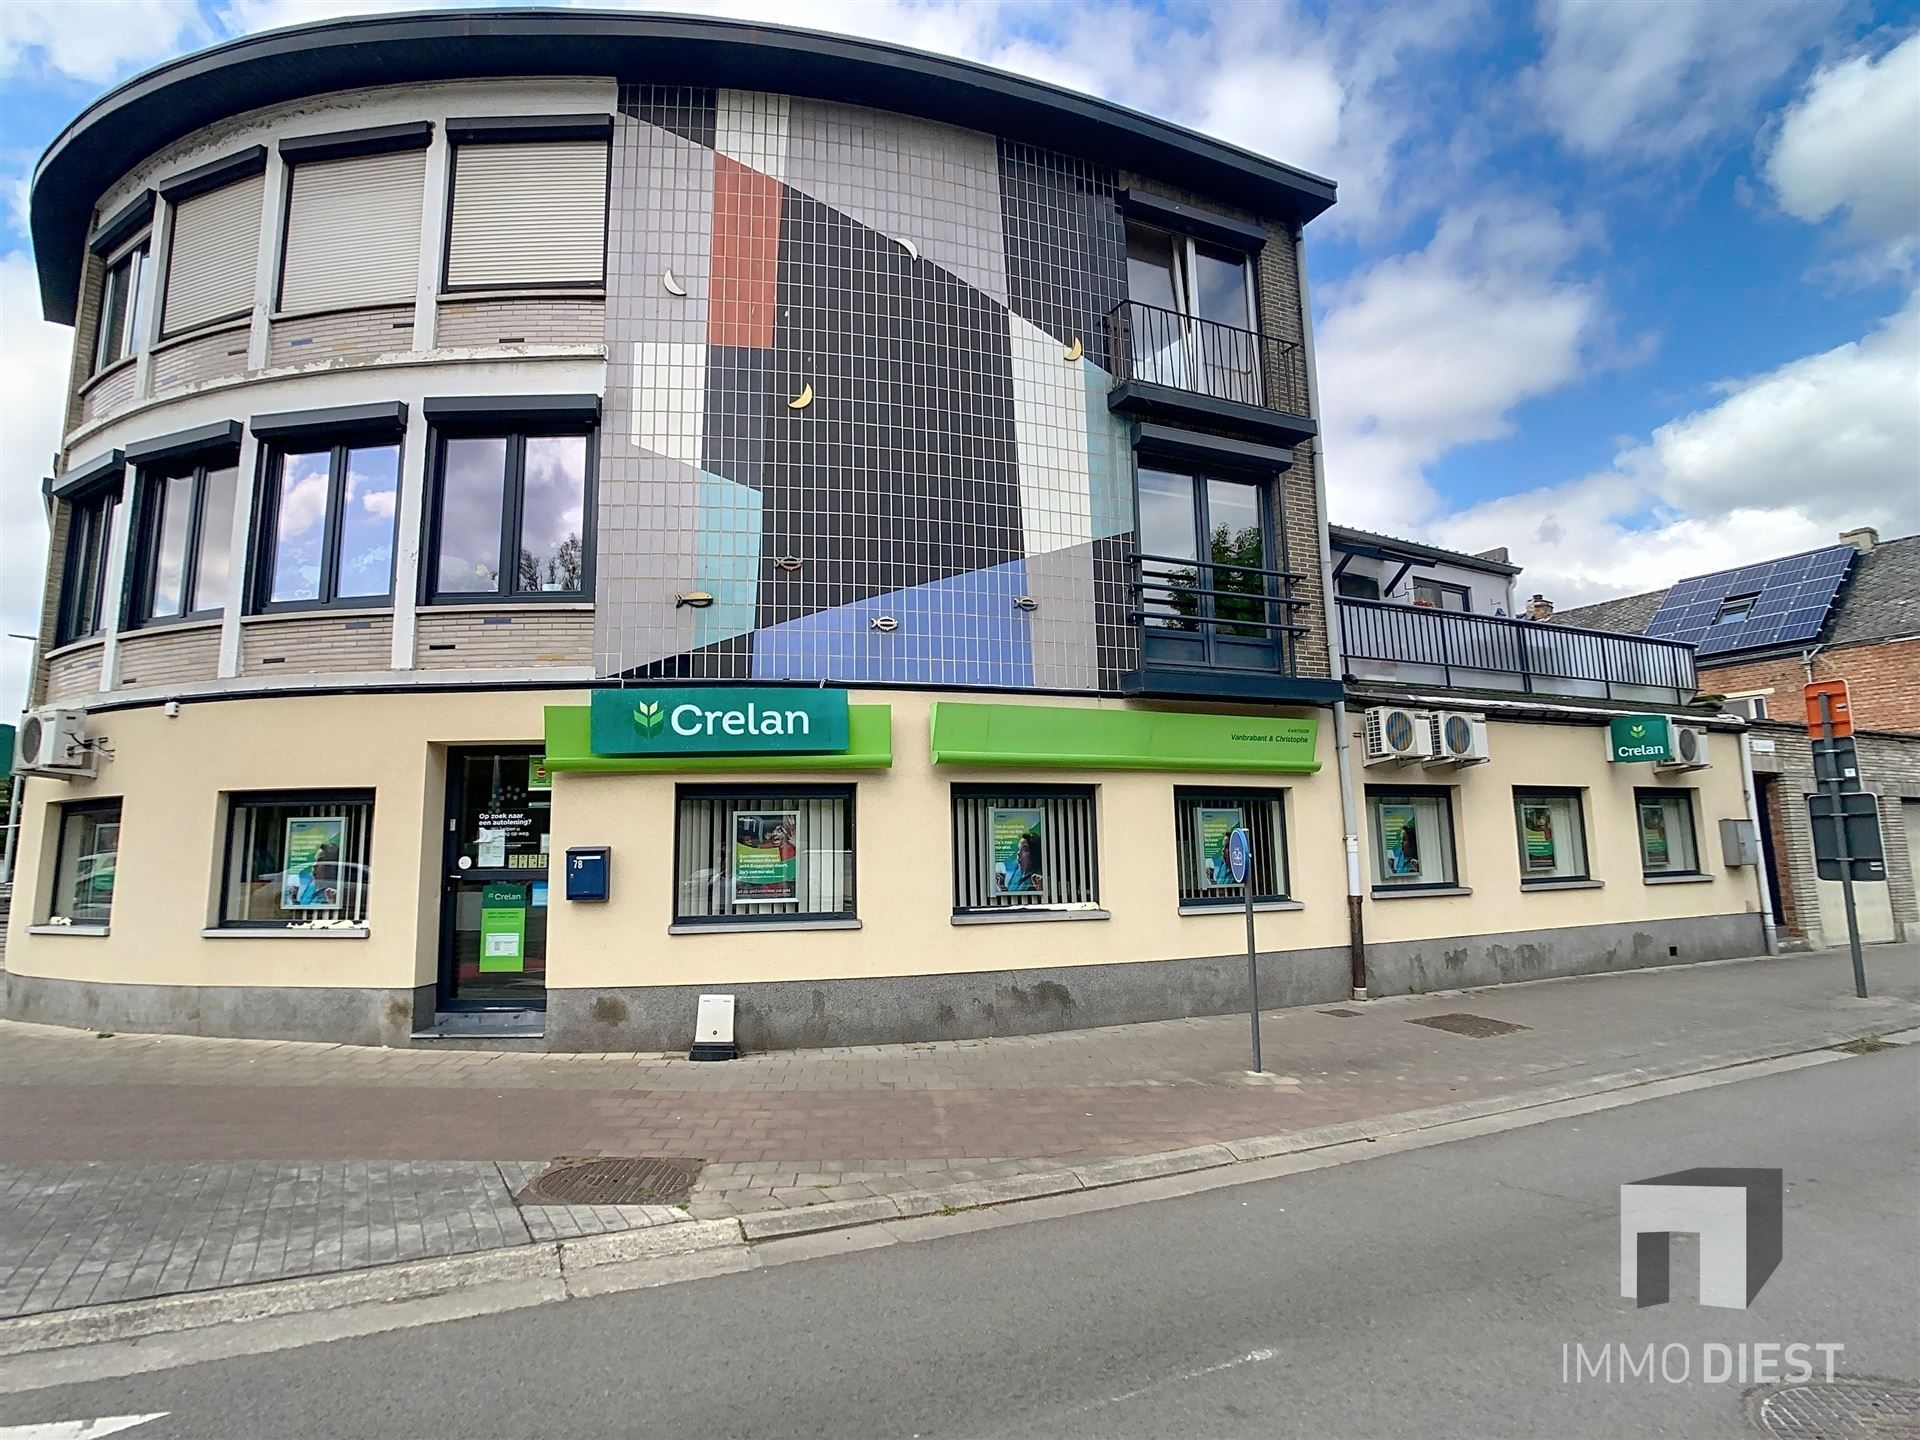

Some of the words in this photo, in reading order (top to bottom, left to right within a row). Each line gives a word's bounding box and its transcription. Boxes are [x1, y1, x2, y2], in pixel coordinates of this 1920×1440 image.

[670, 702, 810, 736] Crelan
[1231, 734, 1267, 742] Vanbrabant
[1275, 735, 1309, 743] Christophe
[1618, 745, 1664, 757] Crelan
[572, 859, 583, 869] 78
